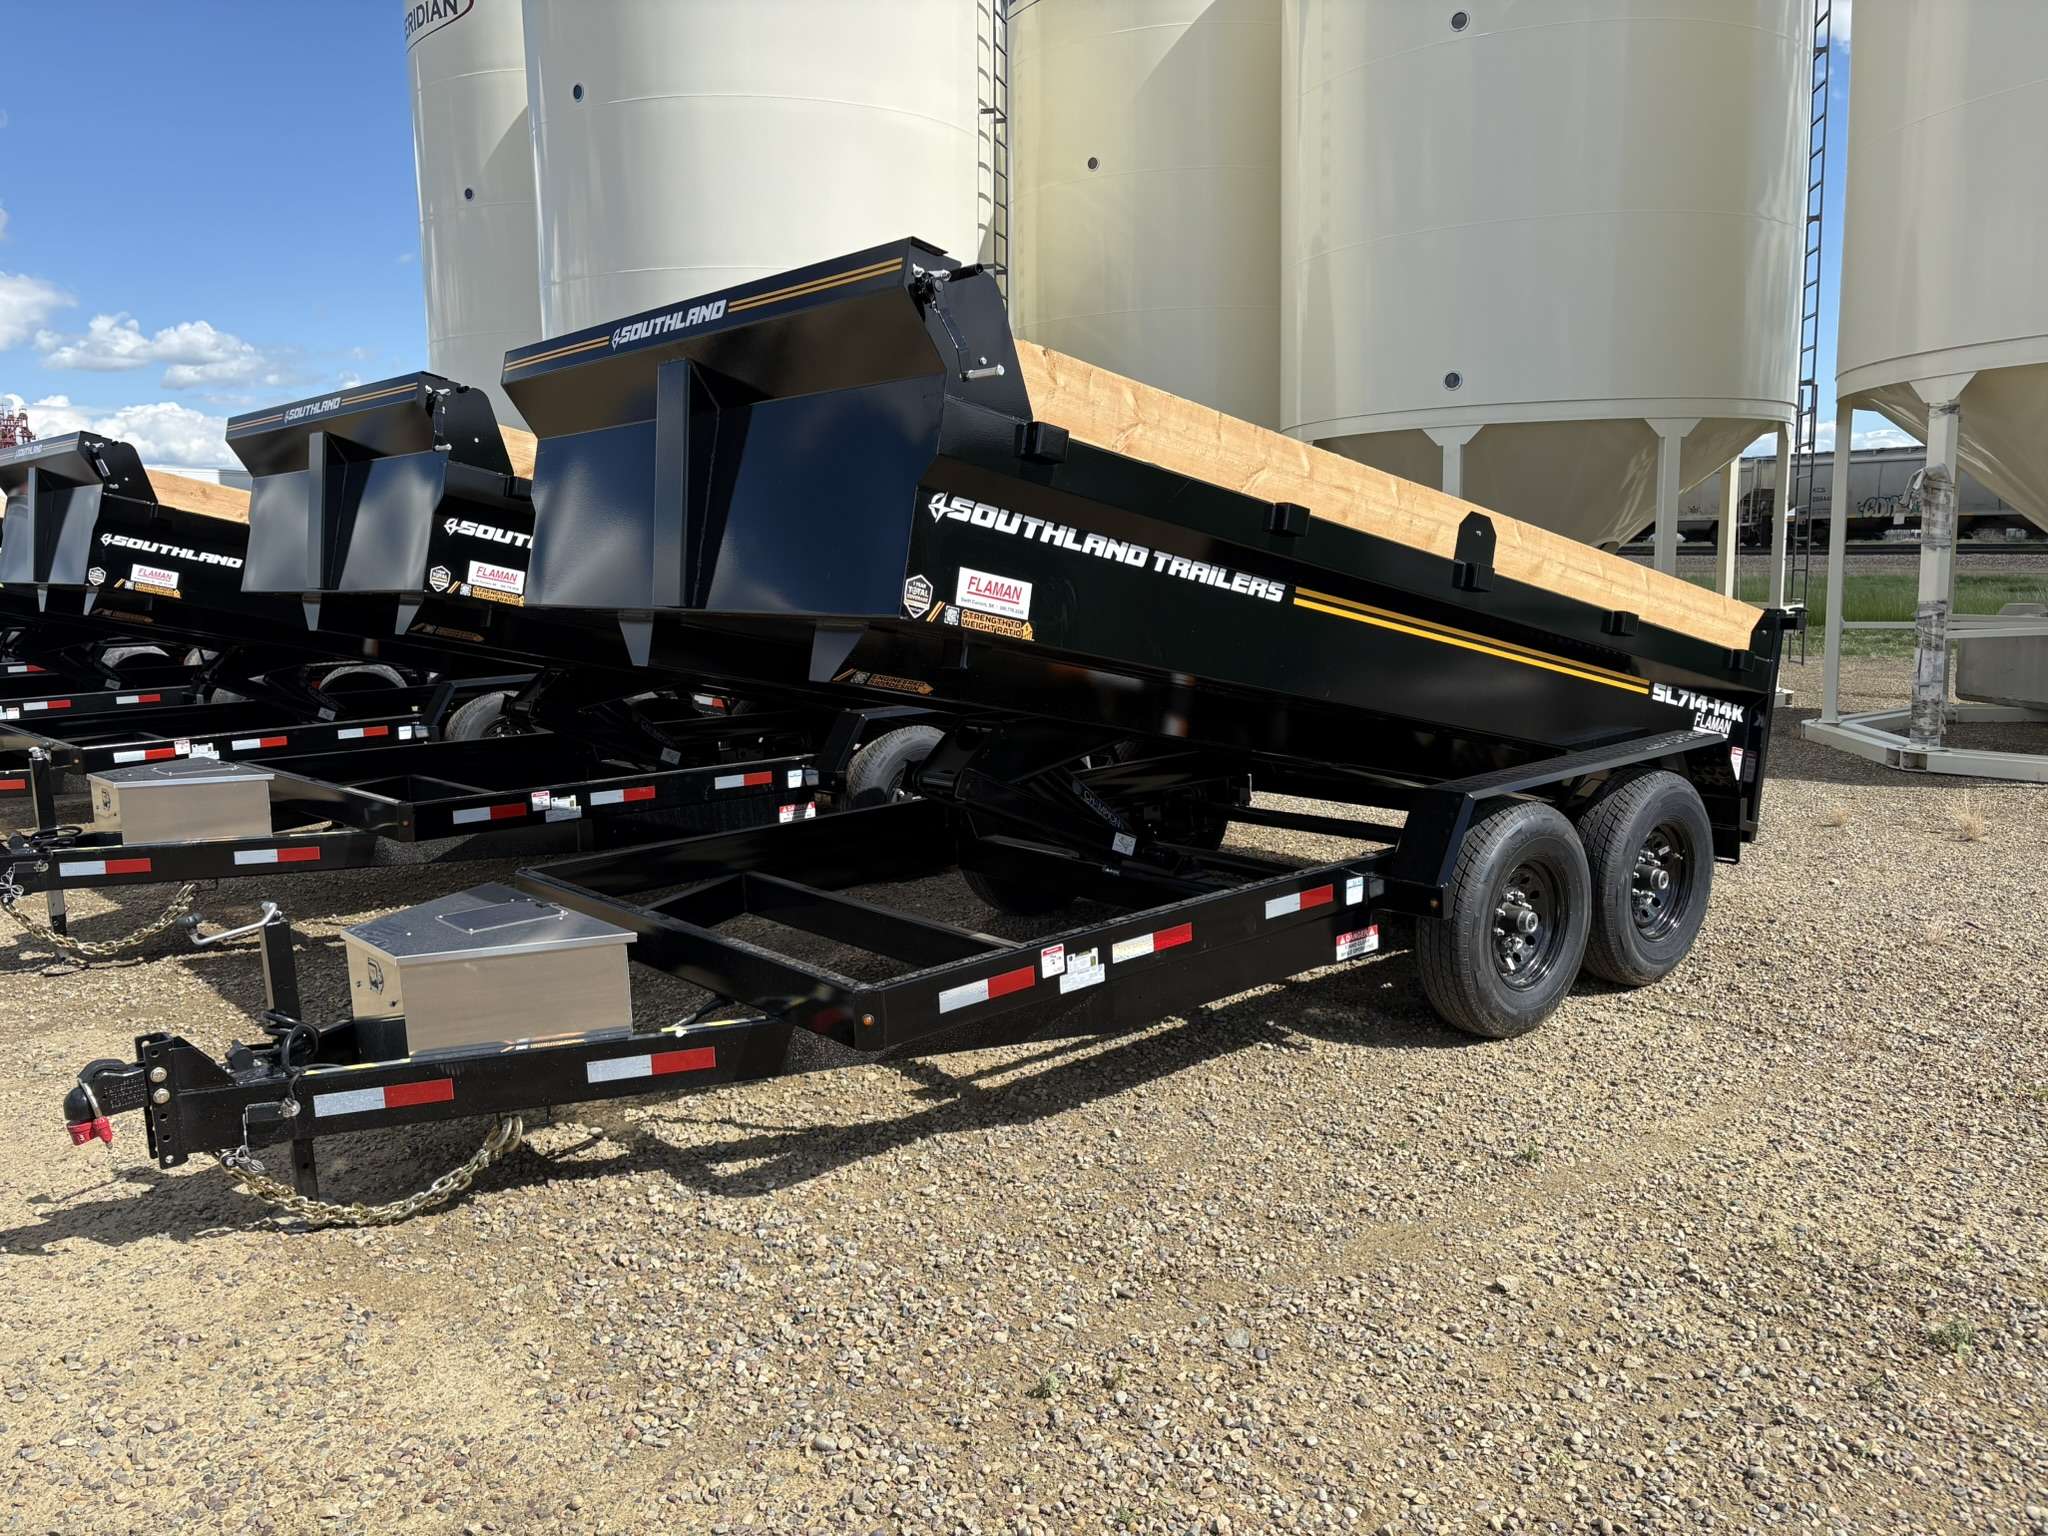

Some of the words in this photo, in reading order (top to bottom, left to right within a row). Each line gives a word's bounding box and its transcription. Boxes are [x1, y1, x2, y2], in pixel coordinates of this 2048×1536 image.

[619, 299, 727, 344] SOUTHLAND
[288, 397, 341, 420] SOUTHLAND
[112, 535, 243, 569] SOUTHLAND
[947, 496, 1150, 568] SOUTHLAND
[1153, 550, 1286, 603] TRAILERS
[137, 568, 173, 583] FLAMAN
[476, 566, 518, 583] FLAMAN
[908, 586, 929, 597] TOTAL
[967, 576, 1023, 601] FLAMAN
[962, 611, 1009, 626] STRENGTH
[962, 619, 996, 633] WEIGHT
[997, 625, 1022, 638] RATIO
[1652, 682, 1744, 723] SL714-14K
[1694, 712, 1732, 733] FLAMAN
